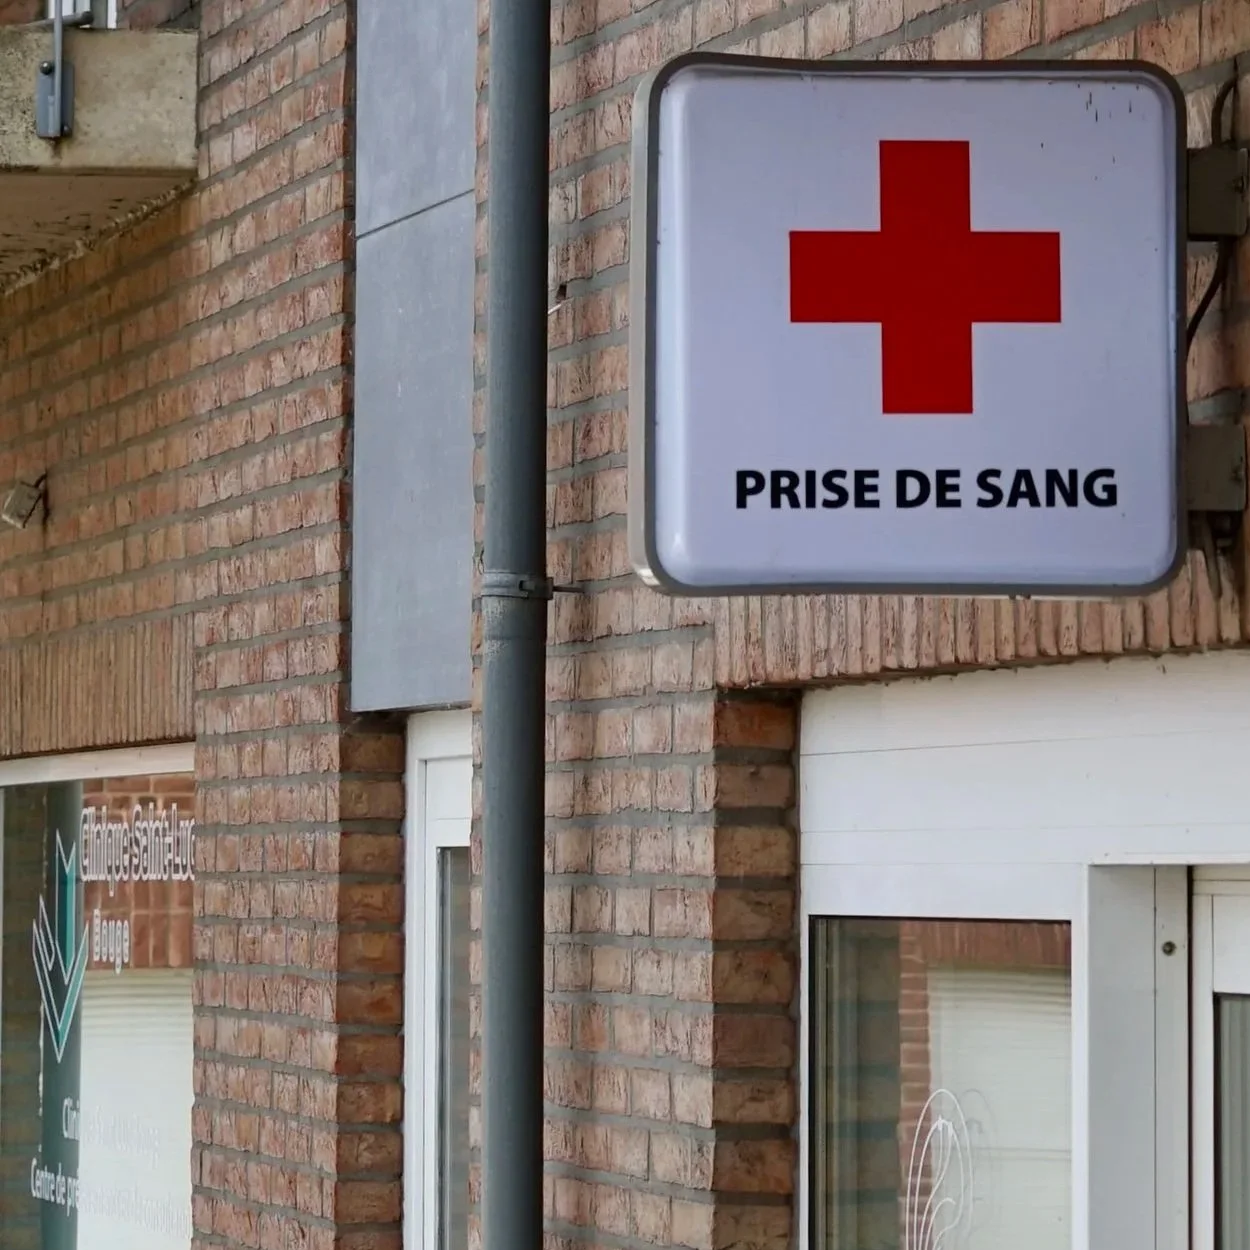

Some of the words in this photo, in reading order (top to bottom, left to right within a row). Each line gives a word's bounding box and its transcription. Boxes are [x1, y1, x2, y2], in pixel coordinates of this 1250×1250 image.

[736, 469, 880, 508] PRISE
[896, 469, 961, 508] DE
[976, 468, 1118, 508] SANG
[80, 804, 130, 897] Clinique
[93, 907, 130, 975] Bouge
[31, 1157, 55, 1203] Centre
